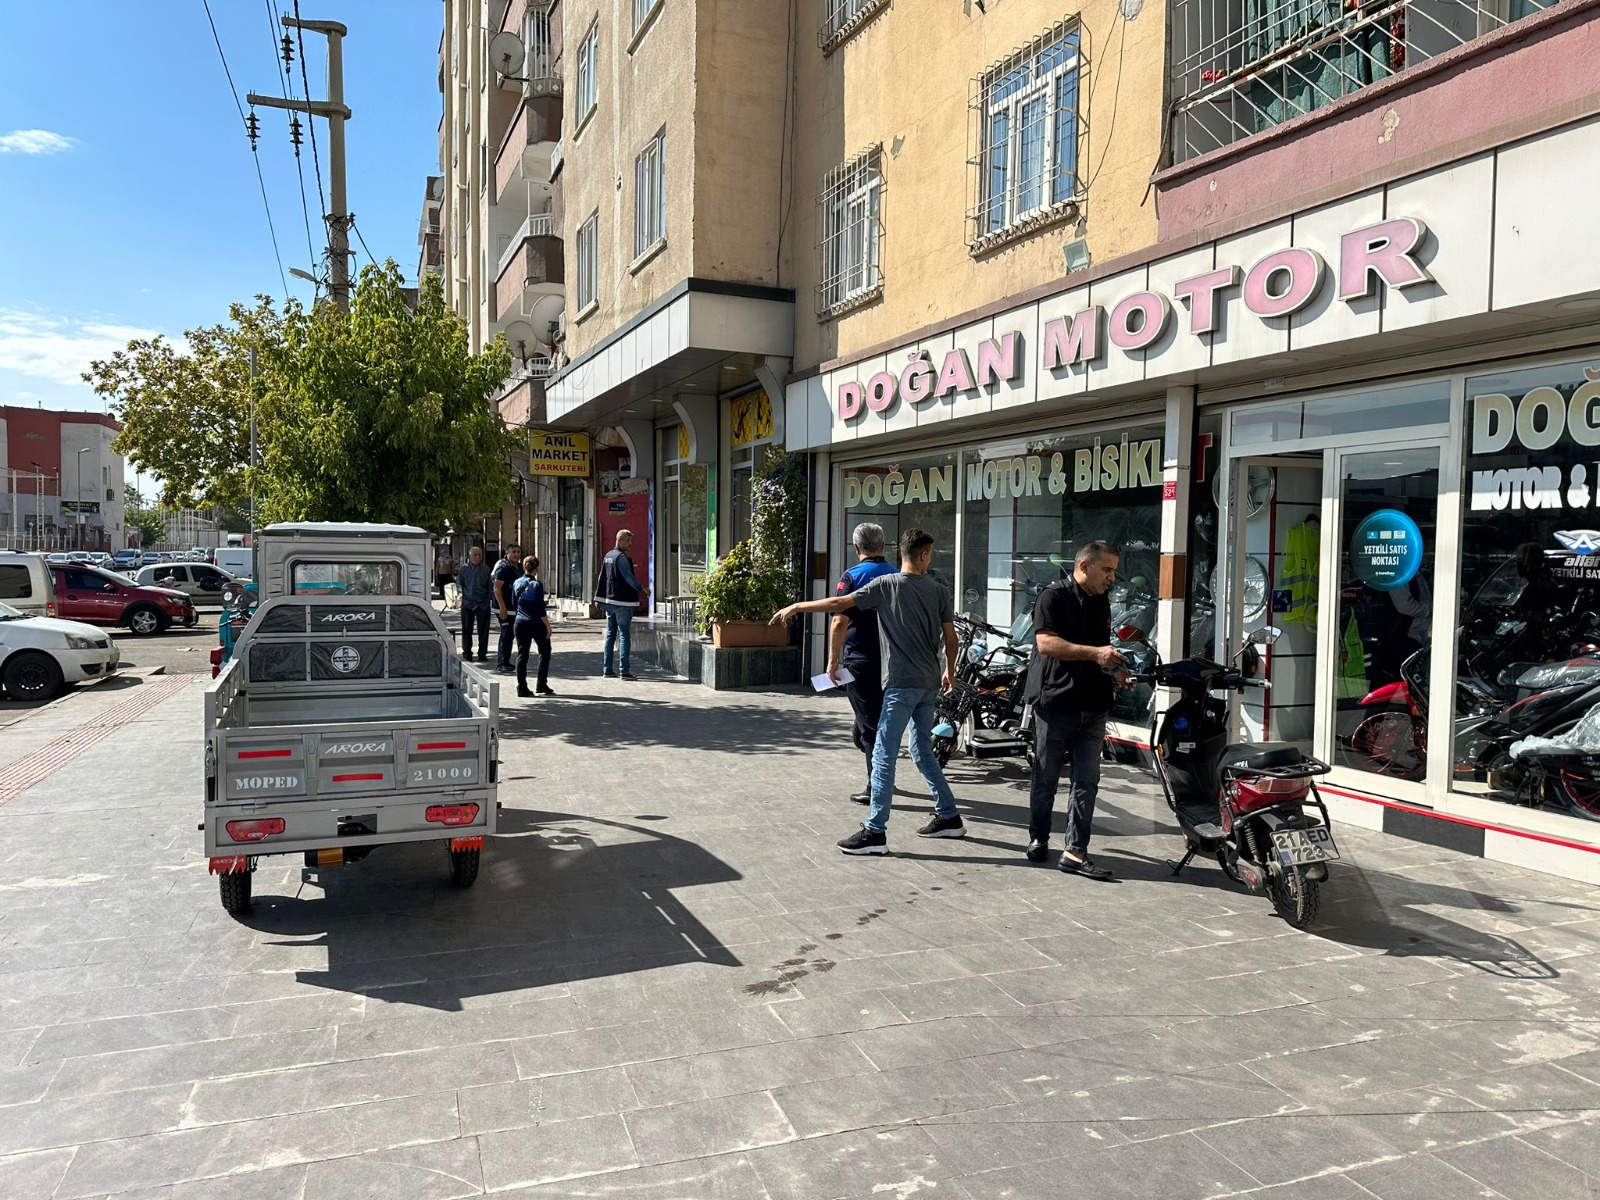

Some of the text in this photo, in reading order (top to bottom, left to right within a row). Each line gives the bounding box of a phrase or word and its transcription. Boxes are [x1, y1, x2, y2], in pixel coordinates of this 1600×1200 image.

[838, 216, 1435, 420] DOĞAN MOTOR
[544, 436, 576, 447] ANIL
[531, 448, 588, 461] MARKET
[845, 463, 953, 508] DOĞAN
[967, 456, 1042, 501] MOTOR
[1048, 452, 1067, 495] &
[1471, 466, 1563, 510] MOTOR
[1567, 463, 1591, 508] &
[1364, 543, 1408, 555] YETKİLİ SATIŞ
[1371, 556, 1399, 566] NOKTASI
[1550, 567, 1584, 578] YETKİLİ
[321, 612, 376, 622] ARORA
[325, 742, 387, 755] ARORA
[414, 767, 473, 782] 21000
[235, 776, 298, 790] MOPED
[1276, 829, 1329, 849] 21 AED
[1291, 845, 1326, 862] 723
